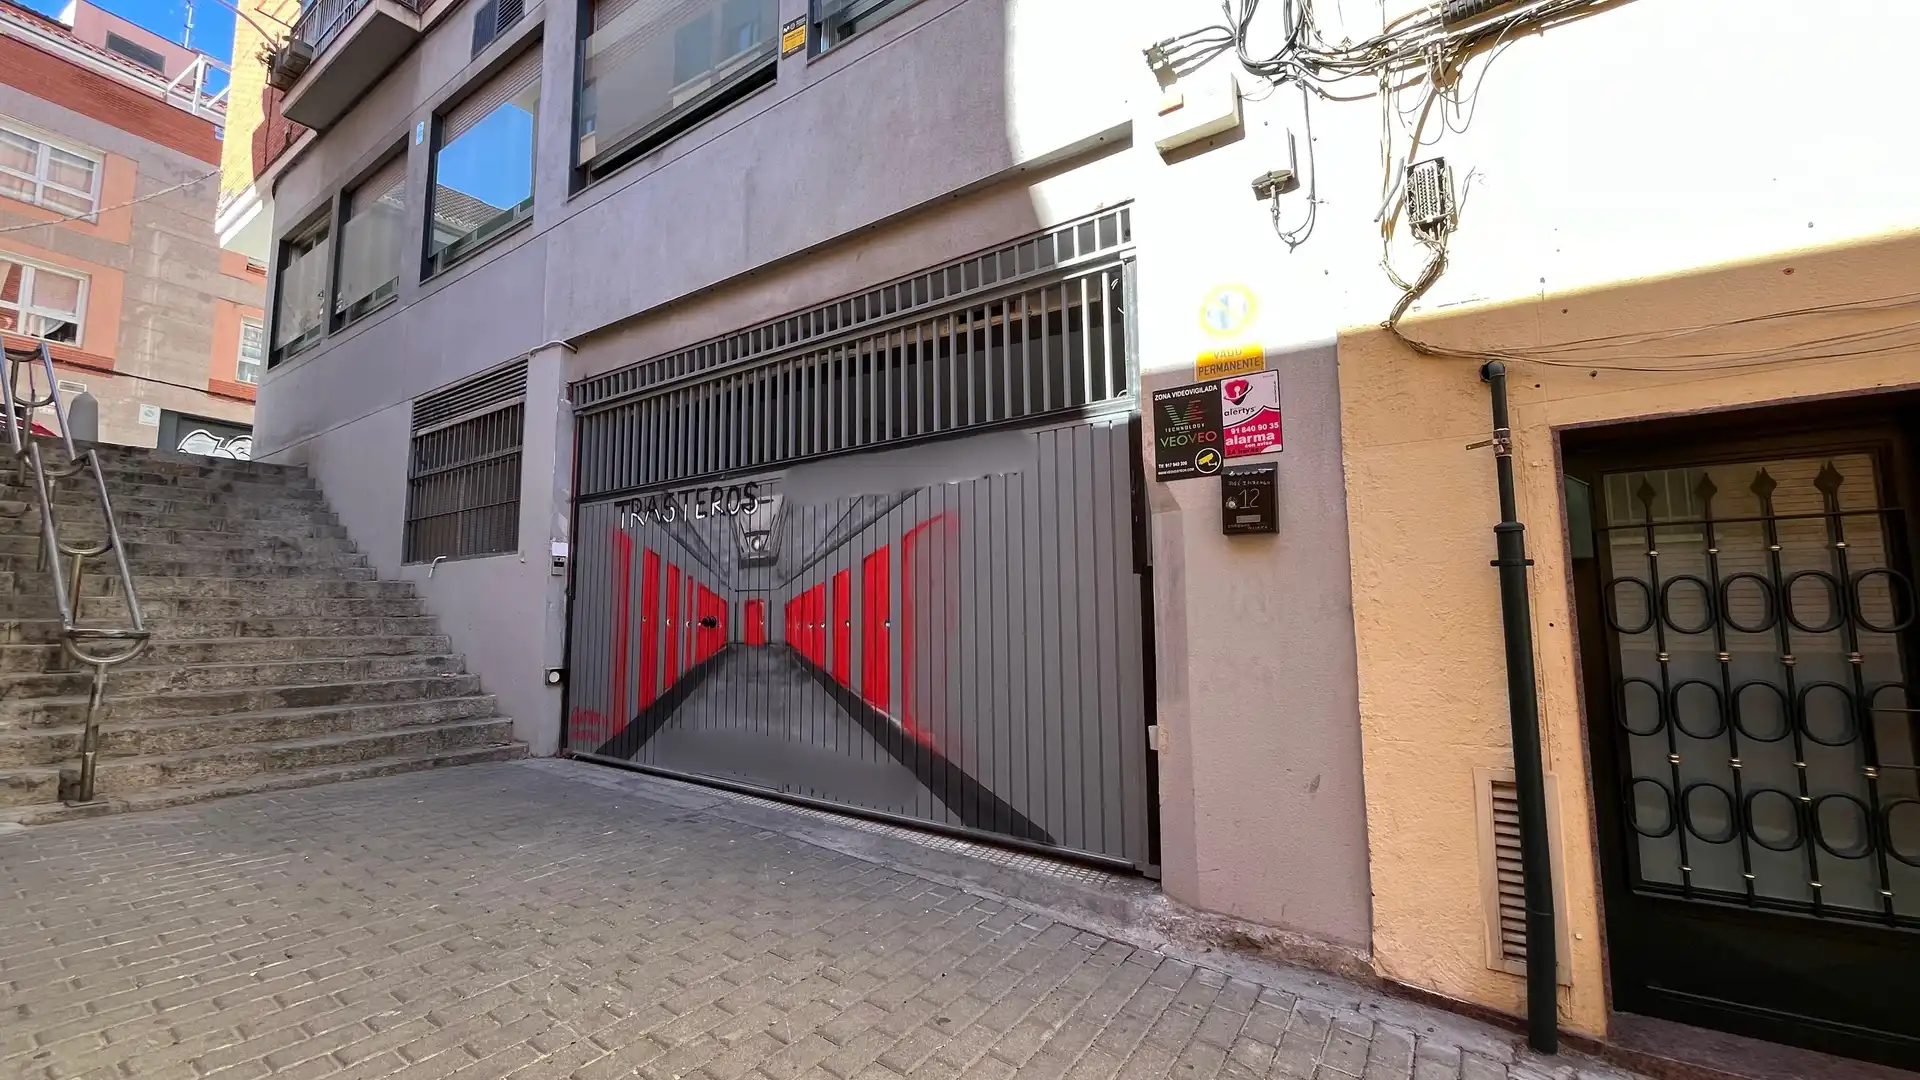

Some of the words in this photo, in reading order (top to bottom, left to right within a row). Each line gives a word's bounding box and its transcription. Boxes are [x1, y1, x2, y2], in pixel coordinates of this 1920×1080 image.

[1198, 356, 1261, 377] PERMANENTE
[1154, 393, 1171, 401] ZONA
[1171, 384, 1218, 398] VIDEOVIGILADA
[1223, 406, 1256, 417] alertys
[1165, 423, 1205, 432] TECHNOLOGY
[1241, 425, 1256, 433] 840
[1257, 423, 1268, 431] 90
[1268, 421, 1279, 429] 35
[1160, 431, 1217, 447] VEOVEO
[1225, 432, 1275, 446] alarma
[614, 481, 760, 530] TRASTEROS
[1238, 488, 1260, 509] 12
